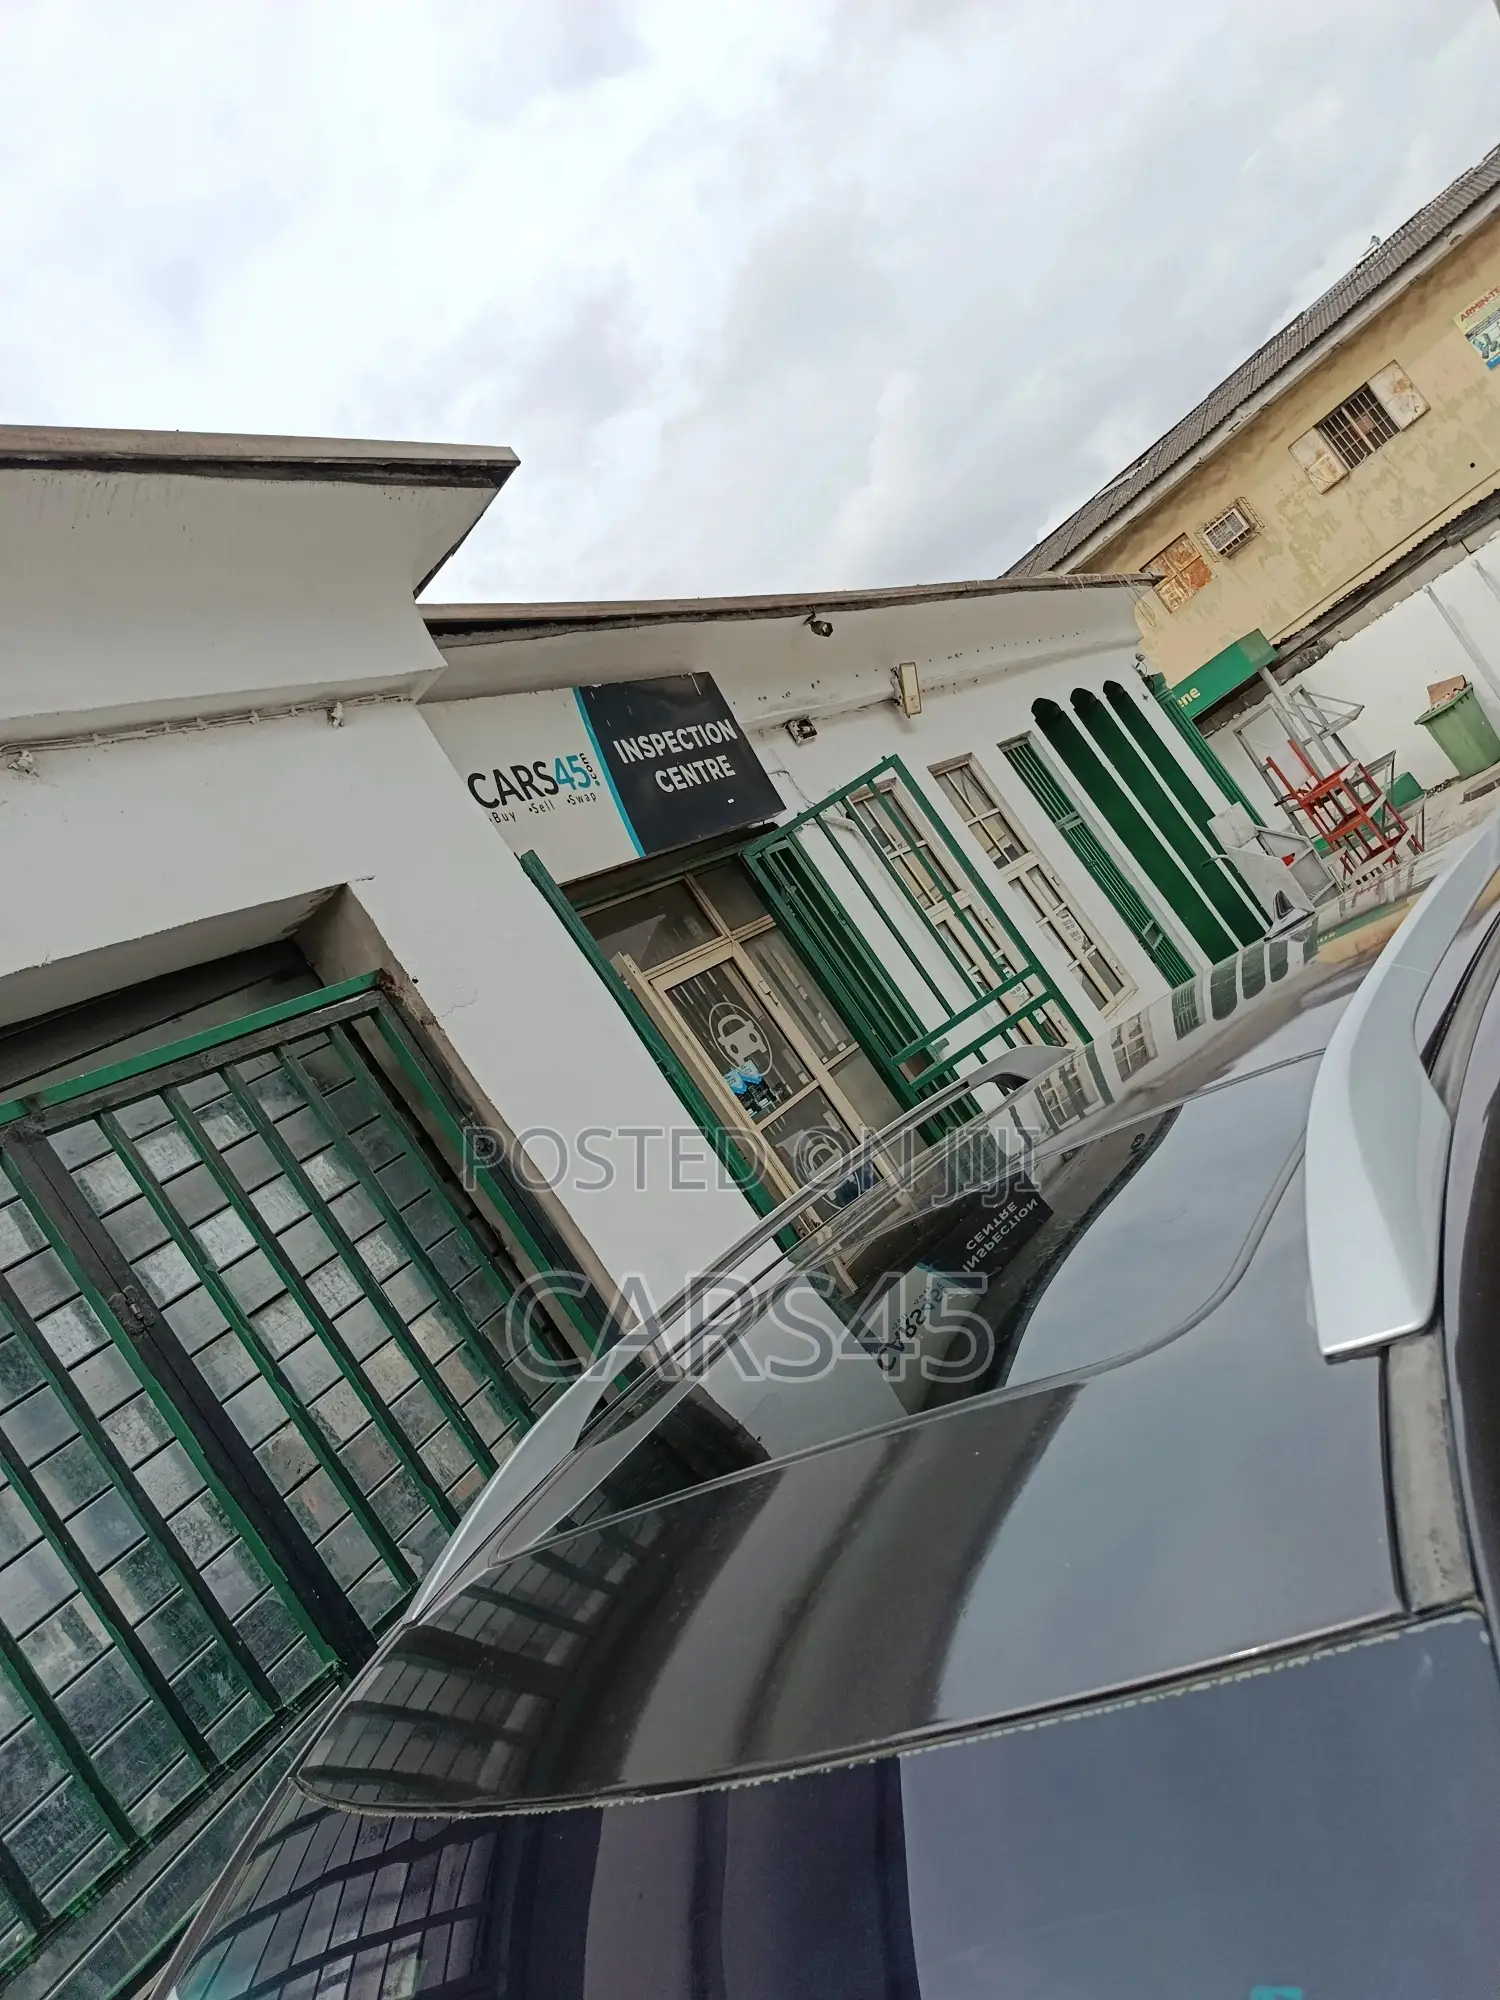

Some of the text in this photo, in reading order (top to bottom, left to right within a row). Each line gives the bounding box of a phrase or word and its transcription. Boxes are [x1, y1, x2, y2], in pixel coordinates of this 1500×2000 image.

[613, 719, 738, 764] INSPECTION
[467, 754, 592, 809] CARS45
[655, 754, 736, 793] CENTRE
[491, 791, 597, 824] Buy Sell Swap
